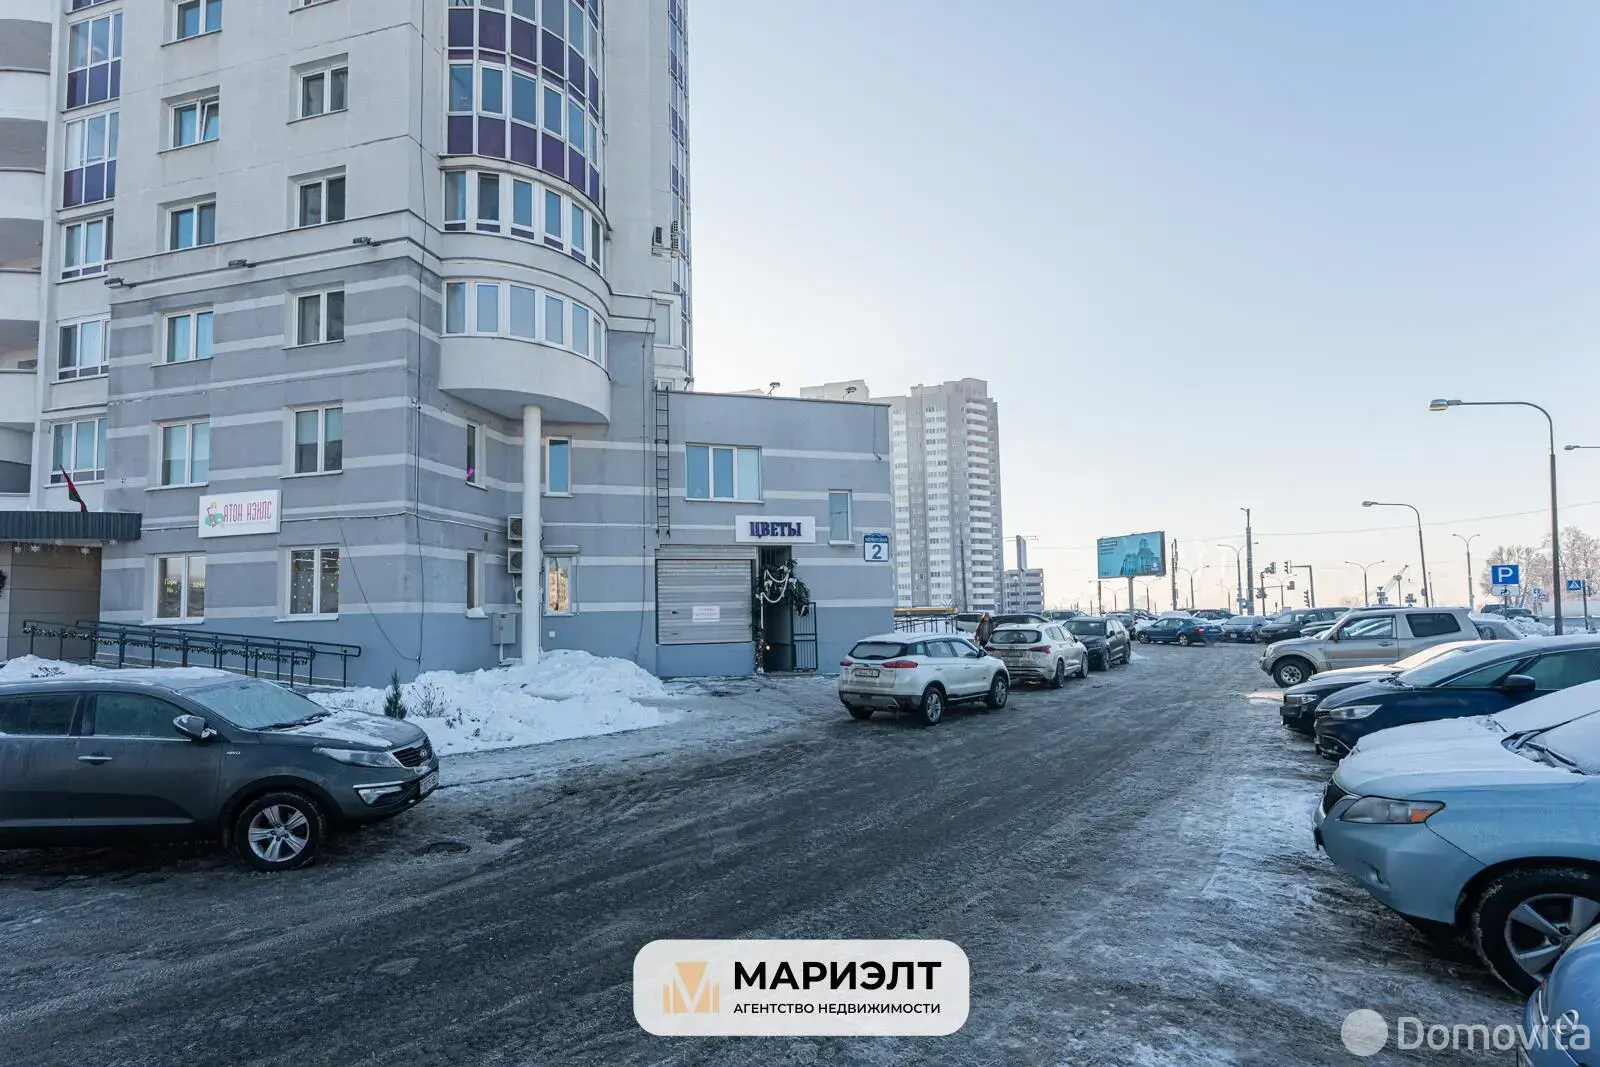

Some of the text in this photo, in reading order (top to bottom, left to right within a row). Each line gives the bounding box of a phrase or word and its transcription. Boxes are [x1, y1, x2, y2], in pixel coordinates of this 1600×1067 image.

[223, 503, 243, 523] АТОН
[749, 521, 802, 540] ЦВЕТЫ
[871, 544, 882, 560] 2
[1498, 567, 1513, 583] P
